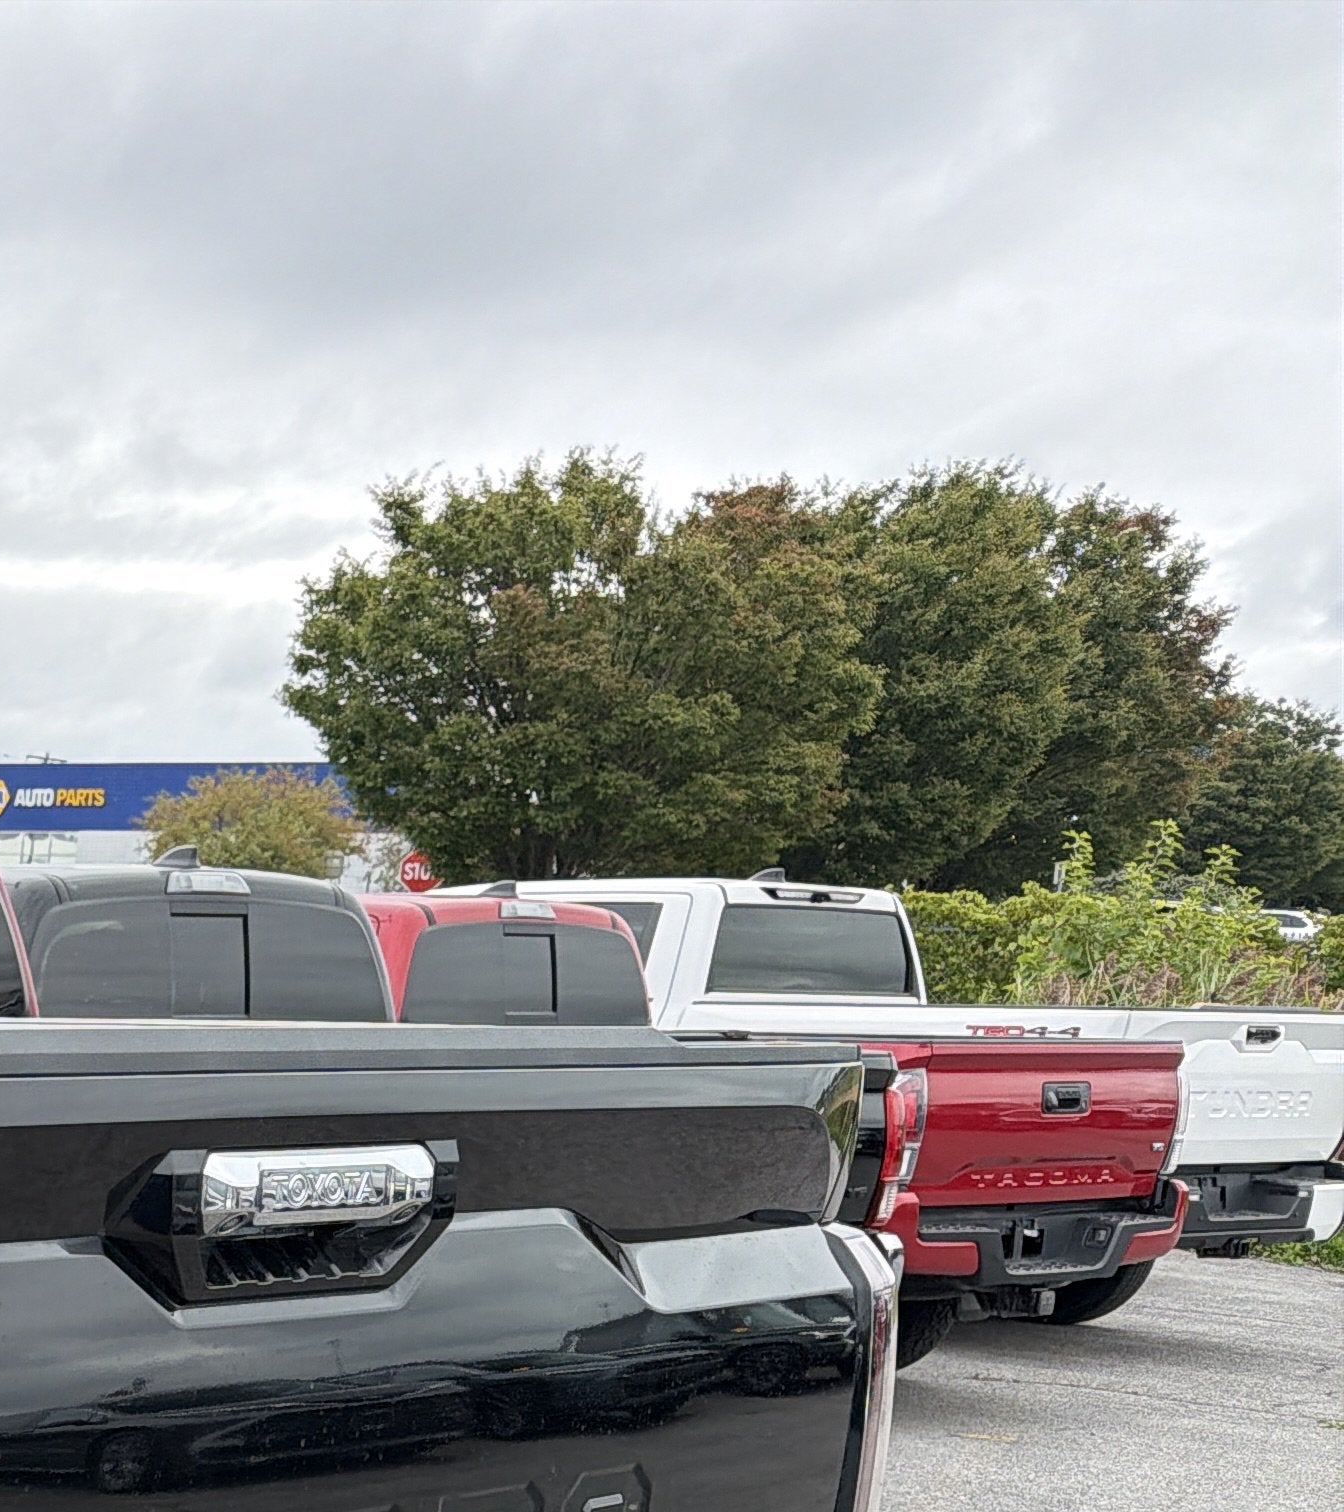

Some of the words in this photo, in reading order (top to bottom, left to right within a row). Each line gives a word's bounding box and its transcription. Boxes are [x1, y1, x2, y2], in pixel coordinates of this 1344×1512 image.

[14, 788, 54, 807] AUTO
[55, 788, 106, 807] PARTS
[402, 862, 433, 881] STO
[969, 1169, 1115, 1189] TACOMA
[270, 1171, 379, 1209] TOYOTA
